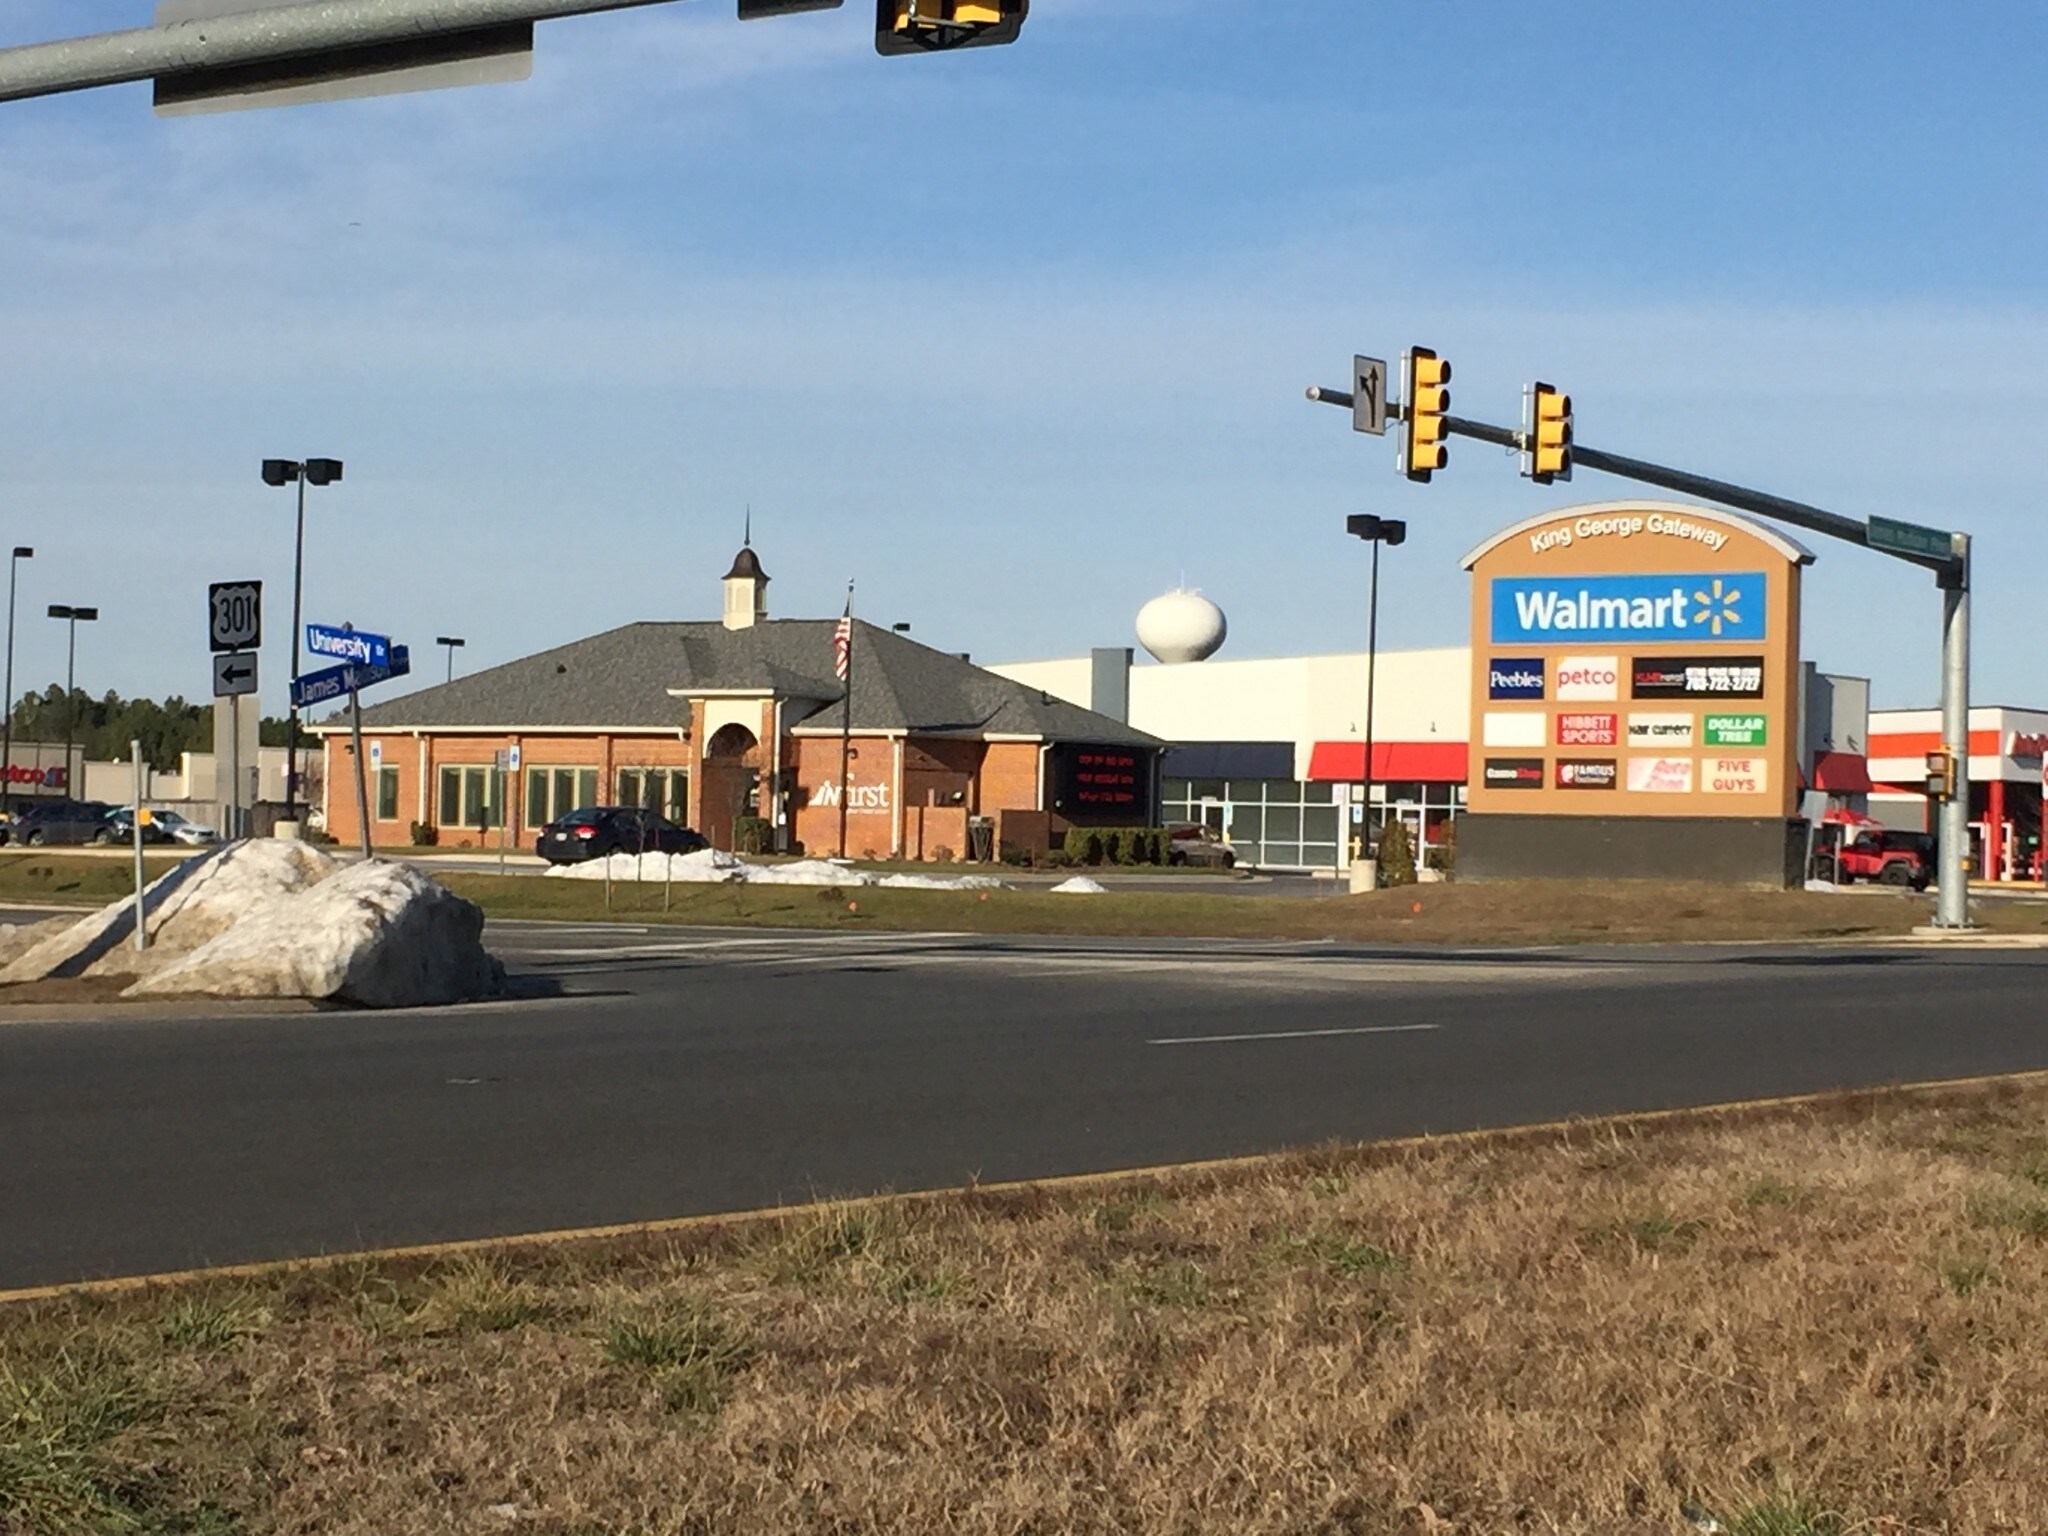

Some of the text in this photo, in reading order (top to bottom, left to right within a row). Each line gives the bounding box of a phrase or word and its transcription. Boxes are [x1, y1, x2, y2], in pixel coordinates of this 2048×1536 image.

[1529, 513, 1730, 553] King George Gateway
[219, 594, 252, 634] 301
[1515, 588, 1688, 631] Walmart
[309, 627, 372, 664] University
[375, 644, 386, 657] Dr
[1490, 670, 1544, 688] Peebles
[1558, 668, 1616, 688] petco
[298, 674, 341, 703] James
[1708, 718, 1764, 730] DOLLAR
[1561, 730, 1613, 744] SPORTS
[1717, 731, 1752, 743] TREE
[1717, 760, 1751, 773] FIVE
[1712, 778, 1756, 792] GUYS
